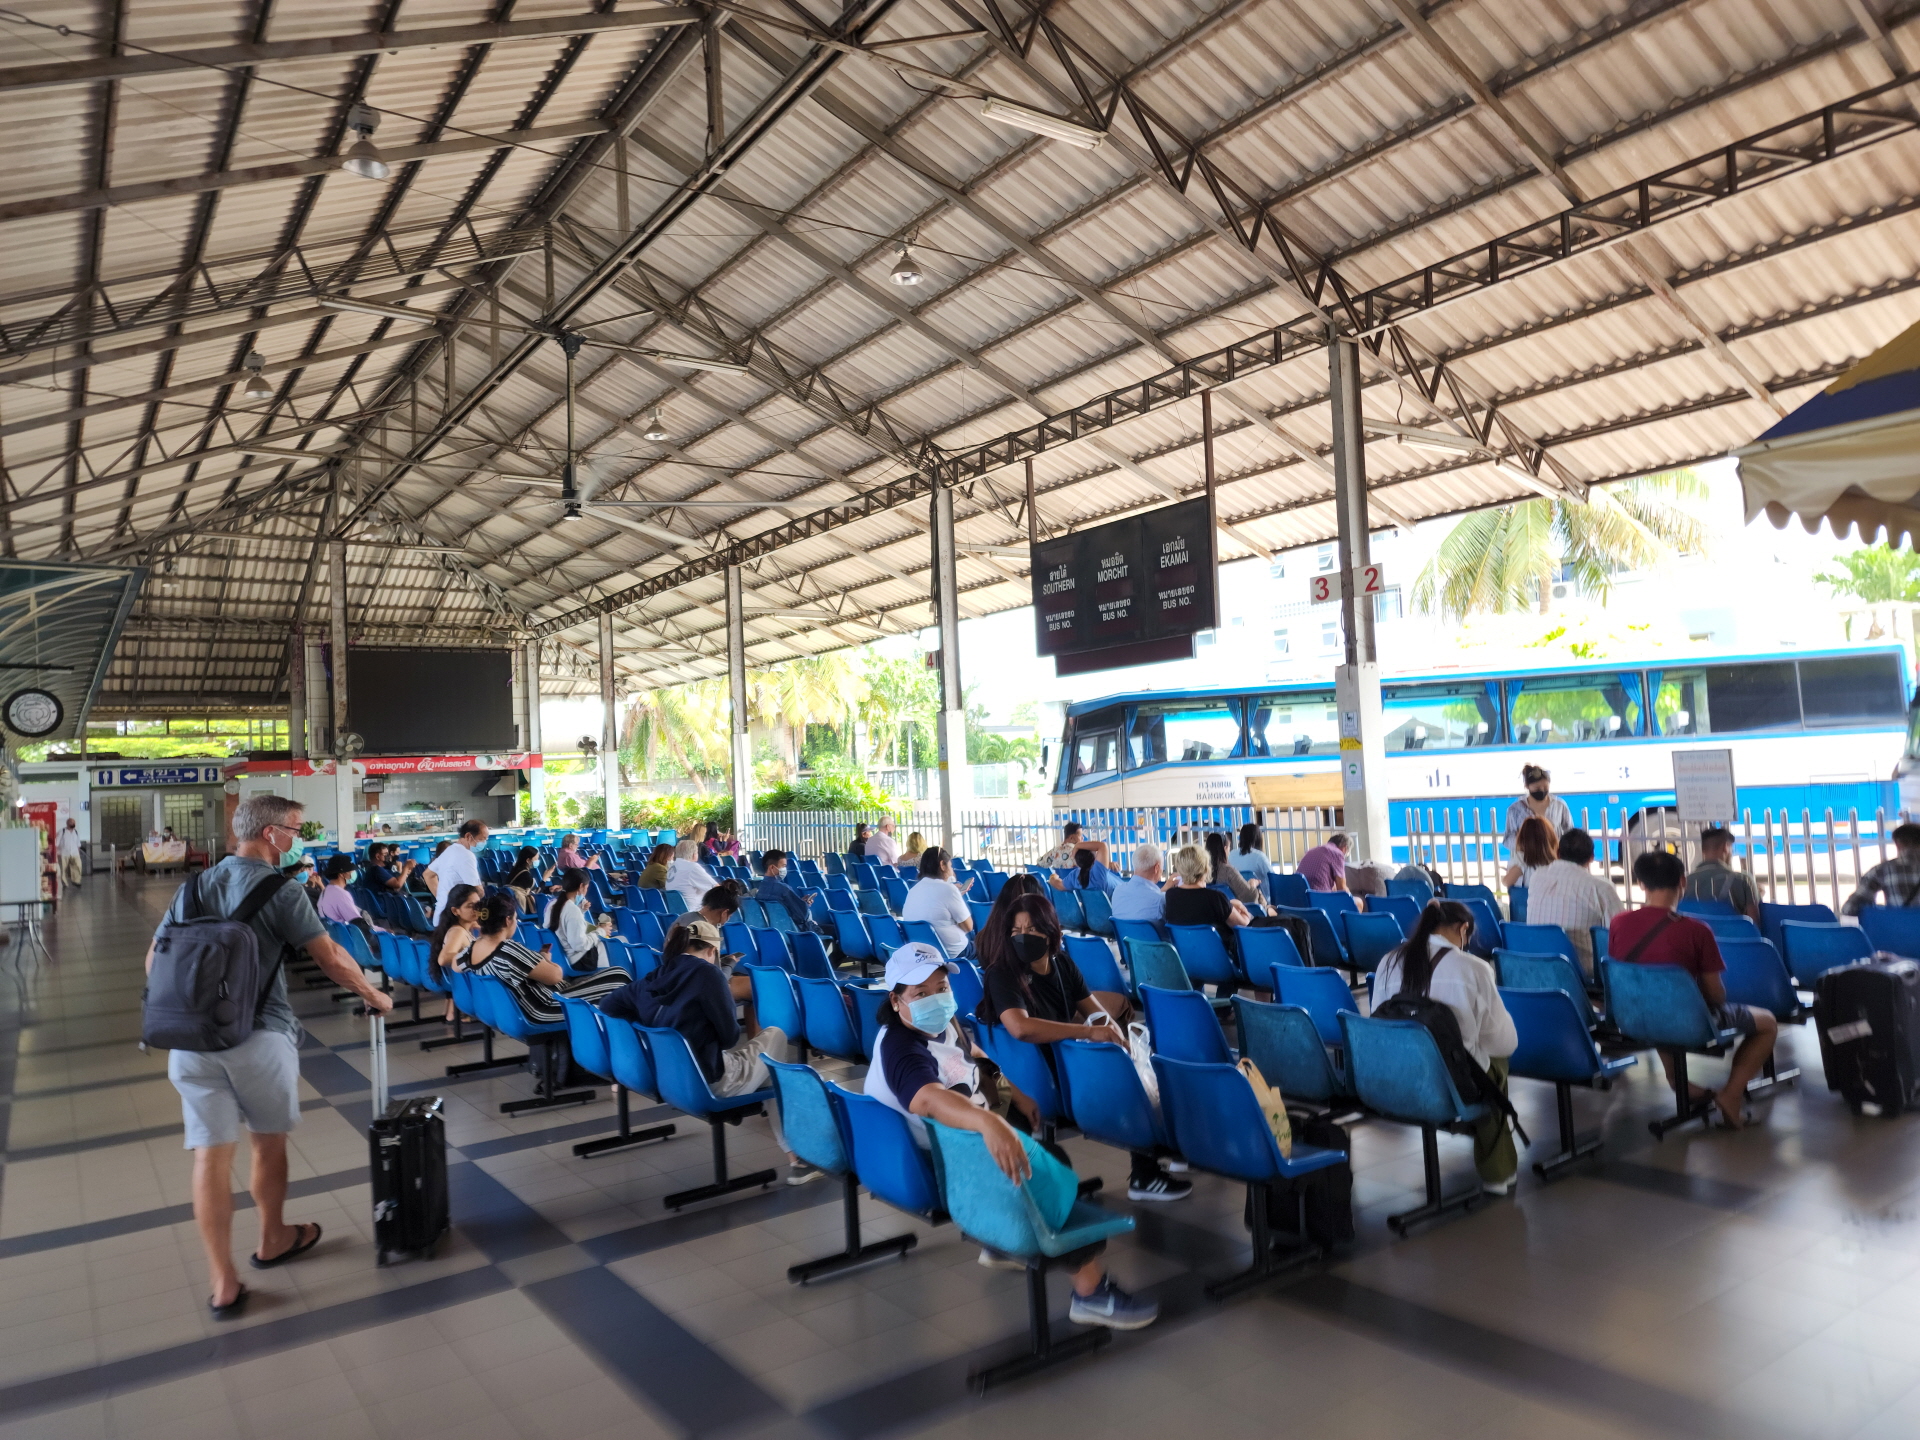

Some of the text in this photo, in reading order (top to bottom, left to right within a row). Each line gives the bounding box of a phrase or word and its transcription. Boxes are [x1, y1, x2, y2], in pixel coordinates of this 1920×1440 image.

[1162, 535, 1185, 554] เอกมัย
[1101, 552, 1124, 569] หมอชิต
[1160, 550, 1189, 568] EKAMAI
[1049, 564, 1067, 581] สายใต้
[1097, 565, 1128, 583] MORCHIT
[1364, 567, 1379, 593] 2
[1042, 578, 1075, 595] SOUTHERN
[1315, 577, 1330, 601] 3
[1163, 596, 1191, 609] BUS NO.
[1102, 609, 1128, 621] BUS NO.
[1049, 620, 1072, 631] BUS NO.
[1196, 791, 1236, 800] BANGKOK
